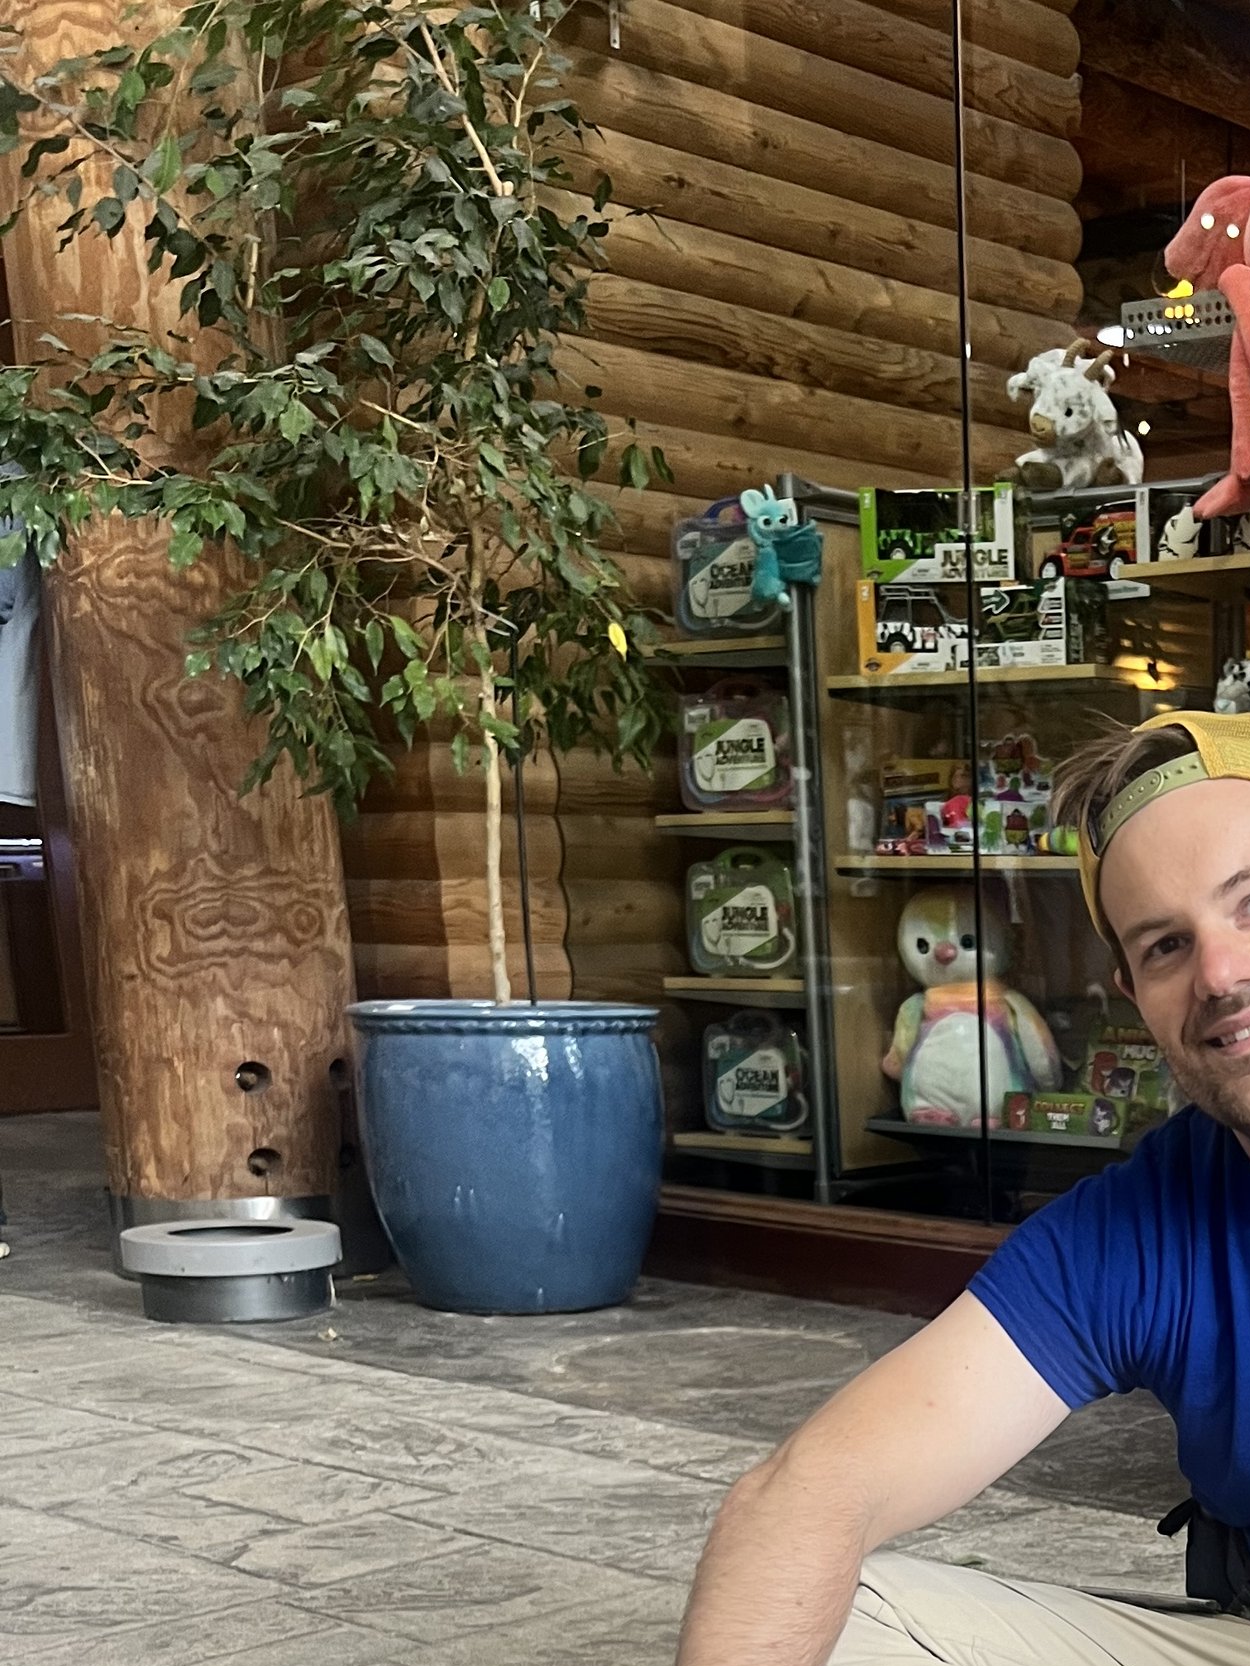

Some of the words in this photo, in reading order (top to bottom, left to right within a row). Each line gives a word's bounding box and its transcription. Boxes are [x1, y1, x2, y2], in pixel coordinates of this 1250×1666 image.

[941, 549, 1008, 567] JUGLE
[715, 737, 765, 755] JUNGLE
[722, 906, 768, 922] JUNGLE
